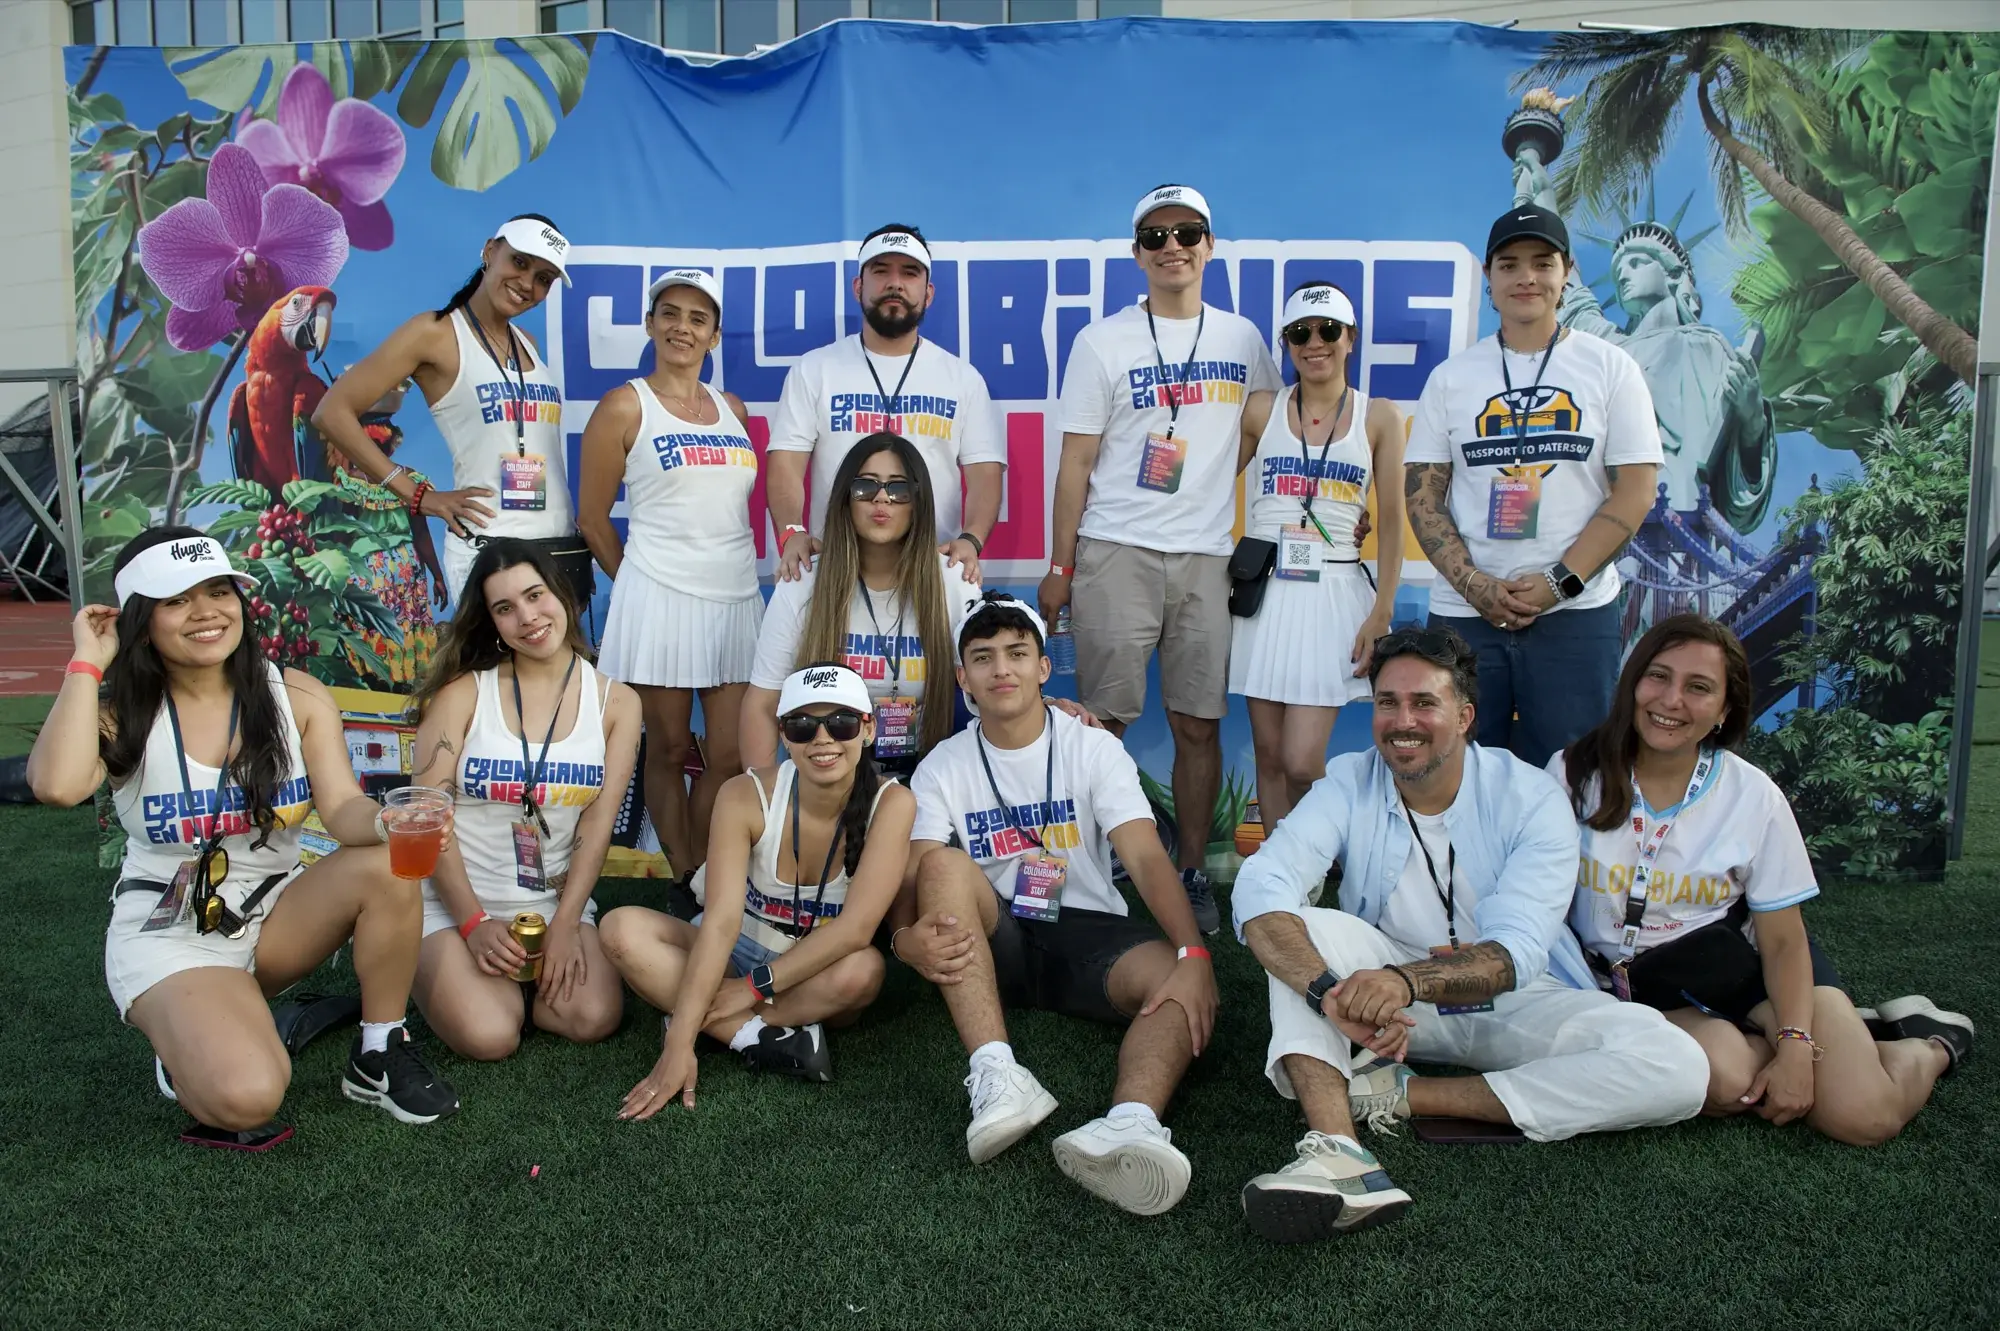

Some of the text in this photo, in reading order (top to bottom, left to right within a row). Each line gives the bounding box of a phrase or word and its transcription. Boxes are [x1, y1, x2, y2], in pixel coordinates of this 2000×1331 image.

[1154, 188, 1182, 201] Hugo's
[541, 227, 566, 250] Hugo's
[882, 233, 909, 246] Hugo's
[1302, 288, 1331, 304] Hugo's
[1132, 390, 1155, 410] EN
[1156, 382, 1204, 408] NEW
[481, 404, 504, 424] EN
[504, 401, 537, 422] NW
[831, 412, 953, 440] EN NEW YORK
[659, 450, 683, 471] EN
[684, 447, 727, 466] NEW
[1466, 442, 1590, 459] PASSPORT TO PATERSON
[516, 480, 532, 489] STAFF
[1262, 479, 1275, 496] EN
[1277, 475, 1318, 497] NEW
[171, 539, 211, 562] Hugo's
[803, 668, 838, 688] Hugo's
[464, 782, 488, 799] EN
[146, 824, 180, 844] EN
[181, 810, 250, 844] NEW
[969, 838, 993, 859] EN
[1023, 865, 1060, 879] COLOMBIANO
[1578, 857, 1731, 906] OLOBIANA
[1030, 886, 1047, 896] STAFF
